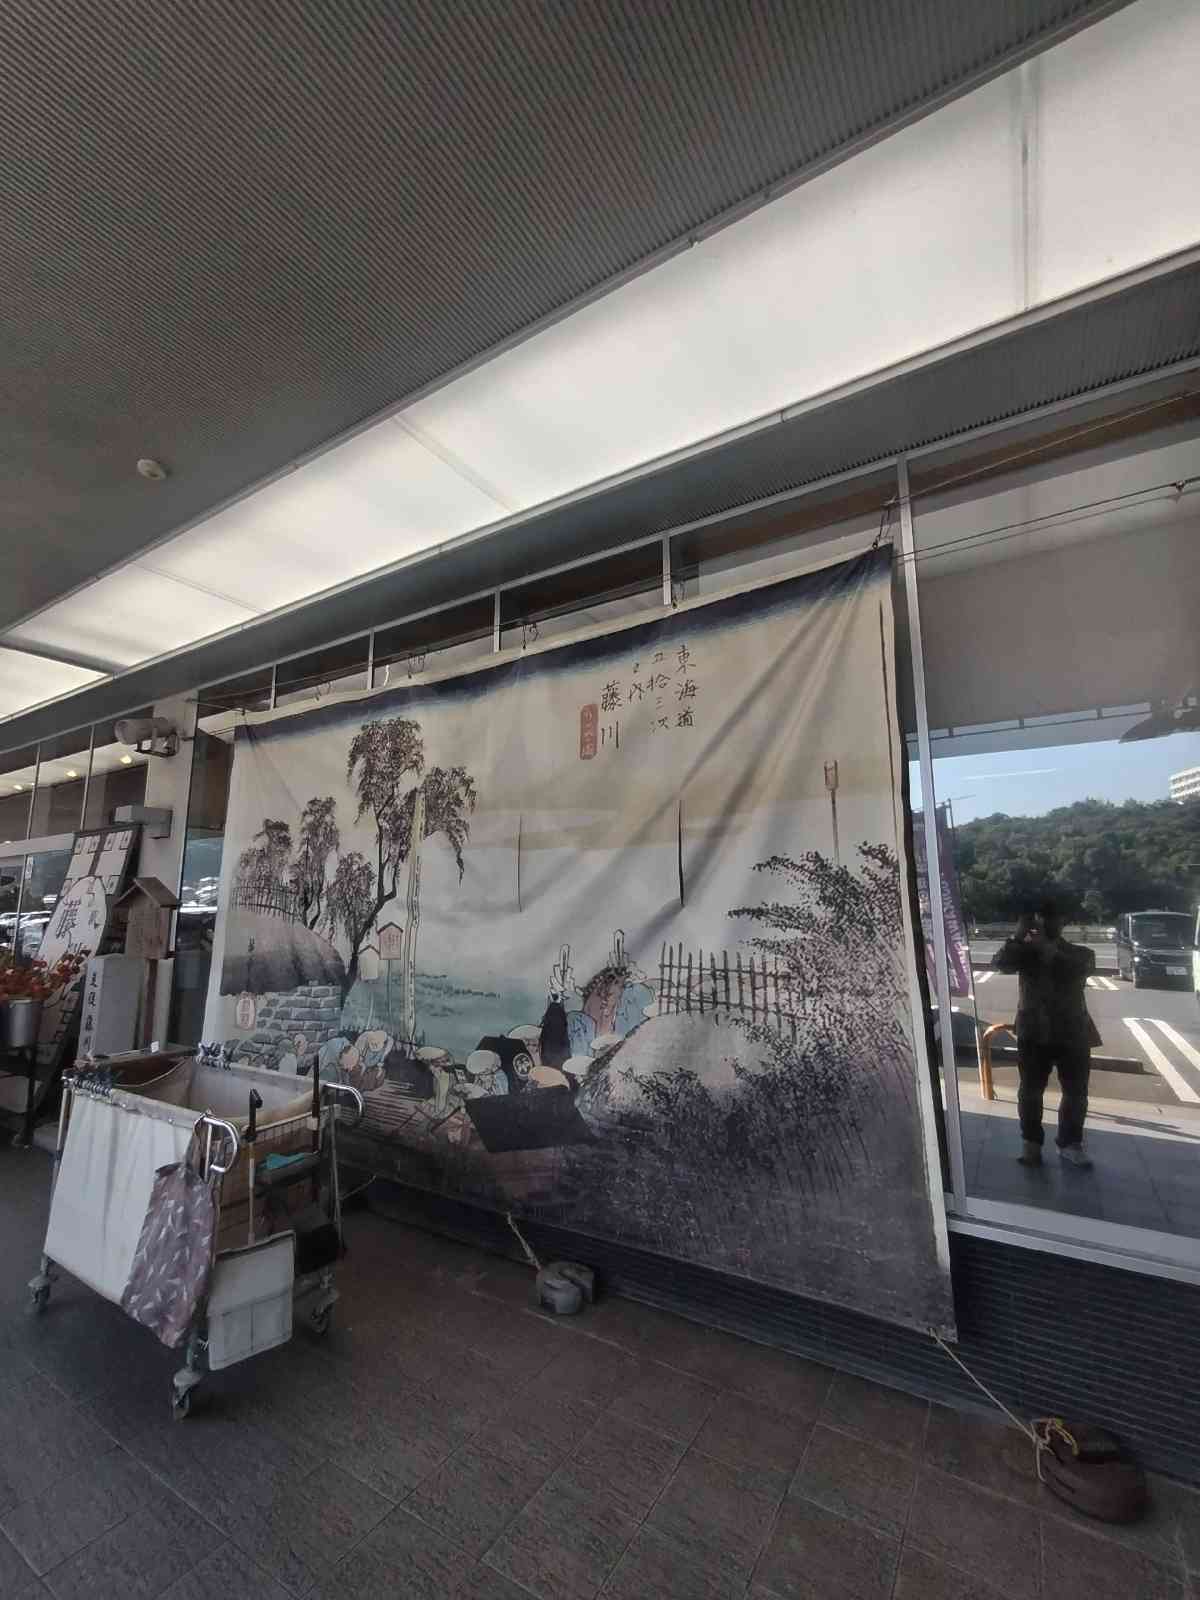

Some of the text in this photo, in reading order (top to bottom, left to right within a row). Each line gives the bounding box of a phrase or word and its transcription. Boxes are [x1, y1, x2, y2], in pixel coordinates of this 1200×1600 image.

[601, 679, 622, 749] 藤川
[675, 644, 700, 728] 東海道
